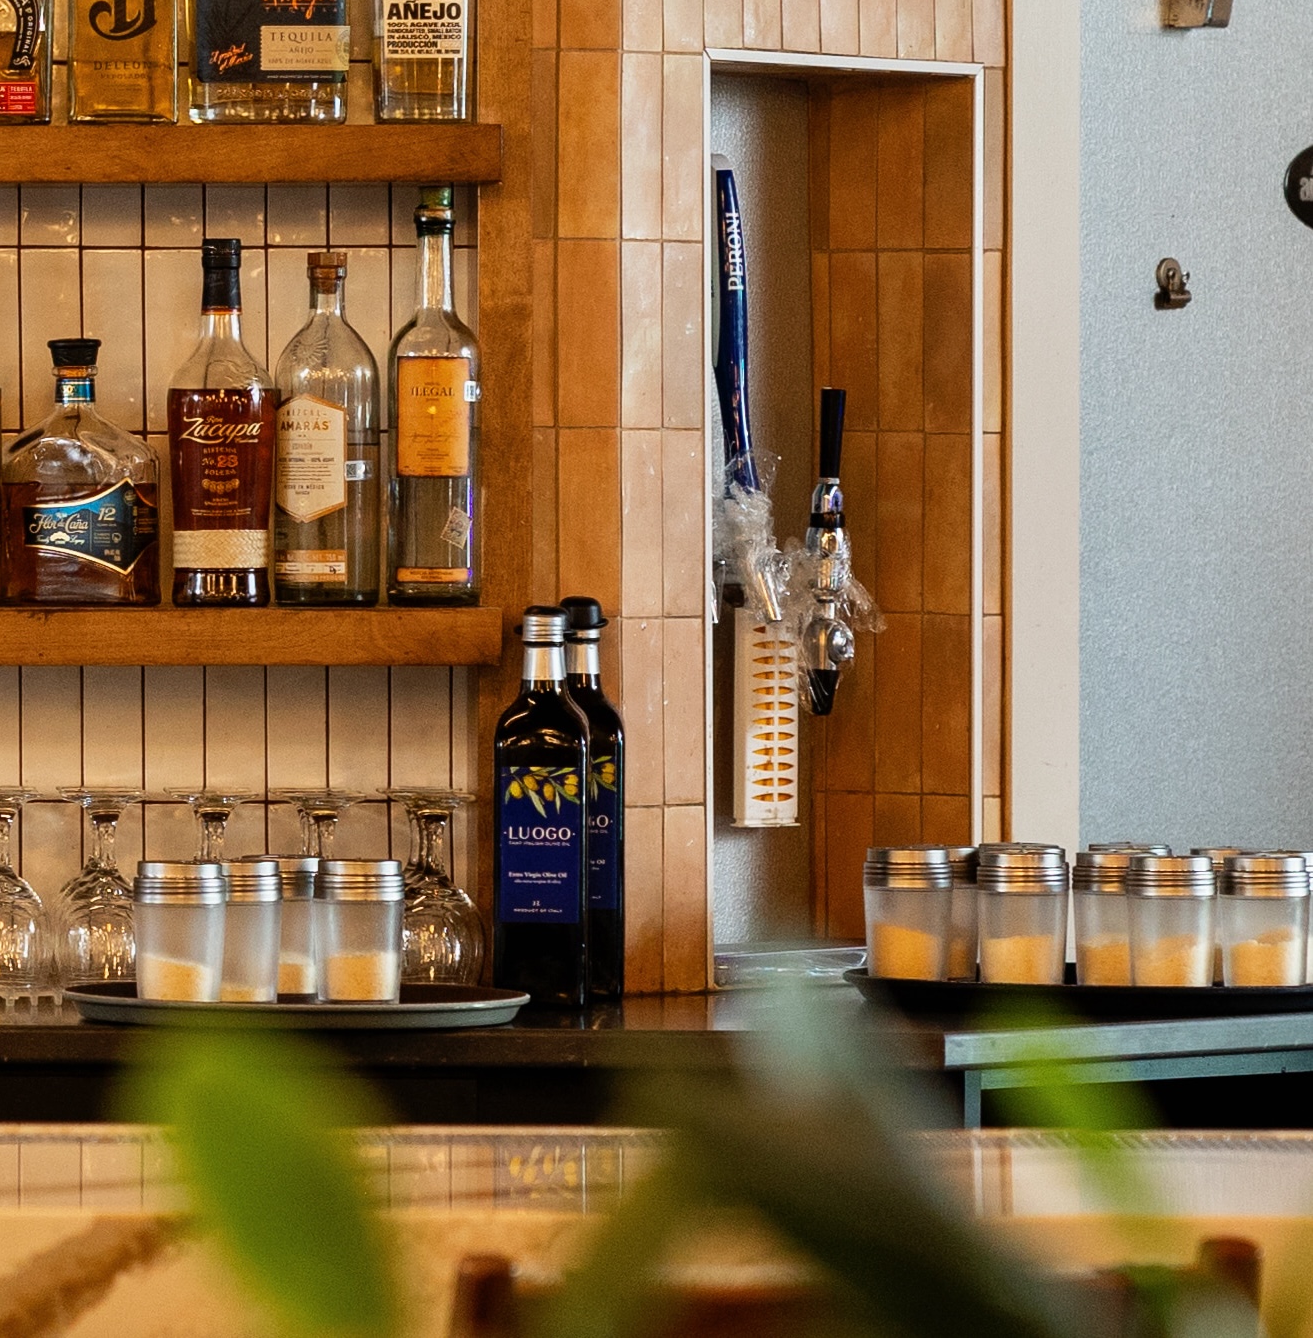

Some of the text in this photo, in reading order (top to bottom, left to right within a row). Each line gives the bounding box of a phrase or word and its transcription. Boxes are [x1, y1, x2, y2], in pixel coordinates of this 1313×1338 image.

[386, 0, 462, 20] AÑEJO
[22, 16, 34, 53] ORIGINAL
[269, 32, 333, 43] TEQUILA
[289, 45, 314, 54] AÑEJO
[387, 39, 439, 49] PRODUCCIÓN
[725, 212, 745, 291] PERONI
[411, 386, 455, 397] ILEGAL
[178, 415, 265, 444] Zacapa
[280, 417, 329, 431] AMARÁS
[217, 454, 239, 467] 23
[97, 507, 116, 521] 12
[29, 513, 57, 534] Flor
[65, 513, 89, 534] Caña
[508, 826, 571, 840] LUOGO
